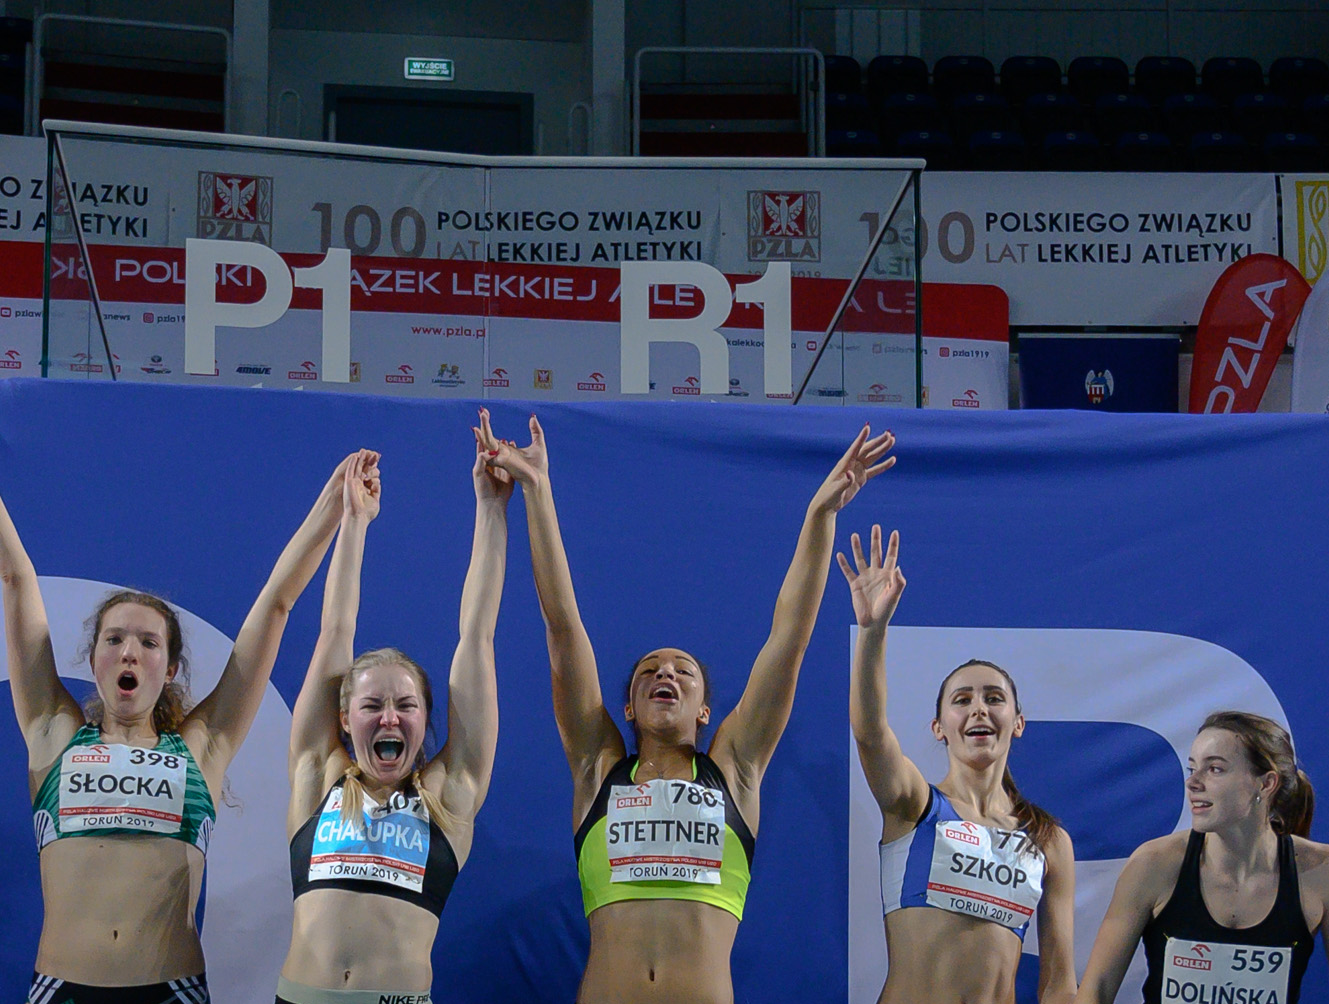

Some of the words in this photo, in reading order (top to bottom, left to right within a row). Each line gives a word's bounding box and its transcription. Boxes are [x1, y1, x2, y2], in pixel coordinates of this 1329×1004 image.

[31, 179, 149, 207] ZIĄZKU
[32, 212, 148, 238] AETYKI
[312, 202, 427, 259] 100
[437, 210, 579, 232] POLSKIEGO
[588, 210, 702, 236] ZWIĄZKU
[985, 211, 1130, 234] POLSKIEGO
[1138, 211, 1252, 238] ZWIĄZKU
[487, 243, 580, 263] LEKKIEJ
[591, 241, 702, 263] ATLETYKI
[985, 242, 1029, 265] LAT
[1037, 241, 1132, 264] LEKKIEJ
[1141, 241, 1253, 264] ATLETYKI
[115, 258, 253, 287] POLKI
[184, 238, 352, 383] P1
[620, 261, 792, 395] R1
[130, 749, 180, 769] 398
[69, 773, 173, 799] SŁOCKA
[618, 797, 650, 808] ORLEN
[609, 820, 720, 846] STETTNER
[947, 831, 979, 845] ORLEN
[329, 863, 368, 875] TORUŃ
[372, 867, 399, 881] 2019
[629, 864, 668, 877] TORUŃ
[672, 867, 698, 878] 2019
[950, 852, 1027, 889] SZKOP
[950, 897, 989, 915] TORUŃ
[991, 908, 1013, 923] 2019
[1175, 957, 1210, 969] ORLEN
[1231, 949, 1284, 973] 559
